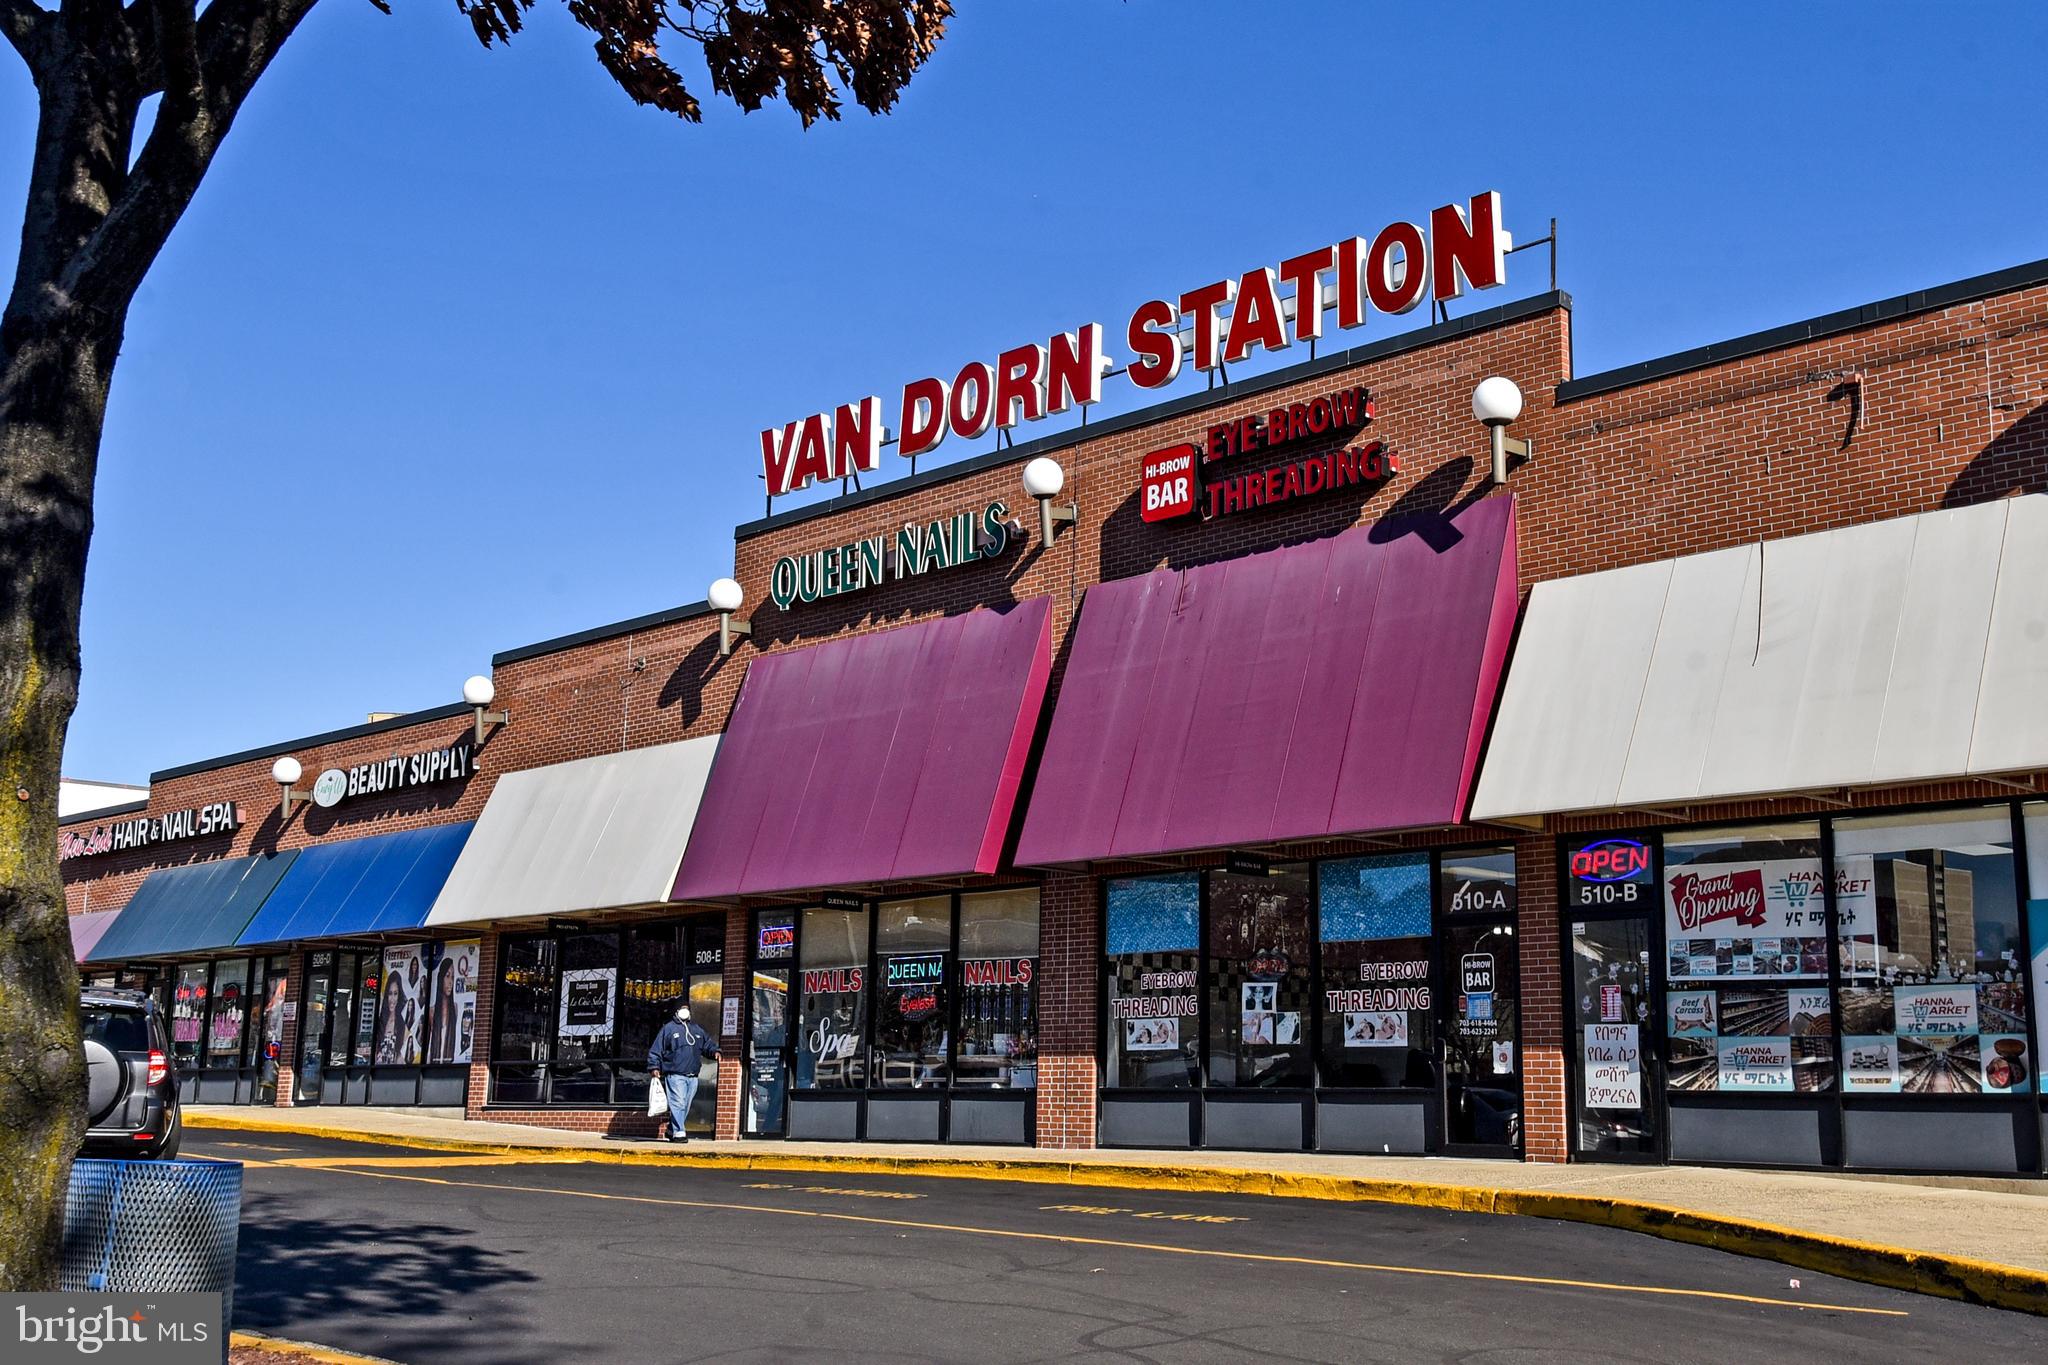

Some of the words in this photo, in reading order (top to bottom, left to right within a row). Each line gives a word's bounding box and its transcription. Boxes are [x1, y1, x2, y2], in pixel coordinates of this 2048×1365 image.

[762, 396, 885, 495] VAN
[898, 323, 1107, 457] DORN
[1127, 190, 1508, 389] STATION
[1207, 387, 1370, 460] EYE-BROW
[1145, 455, 1190, 479] HI-BROW
[1206, 441, 1386, 517] THREADING
[1147, 477, 1188, 511] BAR
[771, 536, 886, 611] QUEEN
[895, 502, 1008, 579] NAILS
[348, 757, 407, 796] BEAUTY
[410, 745, 469, 785] SUPPLY
[114, 818, 149, 850] HAIR
[150, 820, 160, 841] &
[161, 808, 195, 841] NAIL
[200, 801, 233, 835] SPA
[1572, 847, 1649, 877] OPEN
[1685, 871, 1734, 899] Grand
[1788, 869, 1847, 882] HANA
[1581, 883, 1638, 905] 510-B
[1789, 880, 1871, 896] MAKET
[1451, 890, 1507, 911] 510-A
[1679, 886, 1761, 928] Opening
[762, 930, 794, 945] OPEN
[696, 950, 722, 964] 508-E
[1464, 961, 1491, 969] HI-BROW
[804, 968, 862, 994] NAILS
[889, 962, 926, 979] QUEEN
[964, 959, 1033, 986] NAILS
[1140, 971, 1198, 990] EYEBROW
[1361, 961, 1429, 981] EYEBROW
[1465, 972, 1491, 987] BAR
[1112, 995, 1198, 1019] THREADING
[1326, 987, 1431, 1013] THREADING
[1675, 1006, 1704, 1014] Carcass
[1681, 998, 1700, 1008] Beef
[1914, 997, 1954, 1006] HANNA
[1916, 1006, 1970, 1016] MARKET
[1459, 1019, 1498, 1027] 703-618-4464
[1459, 1028, 1498, 1036] 703-623-2241
[810, 1017, 852, 1063] Spa
[1735, 1047, 1772, 1055] HANNA
[1736, 1055, 1786, 1065] MARKET
